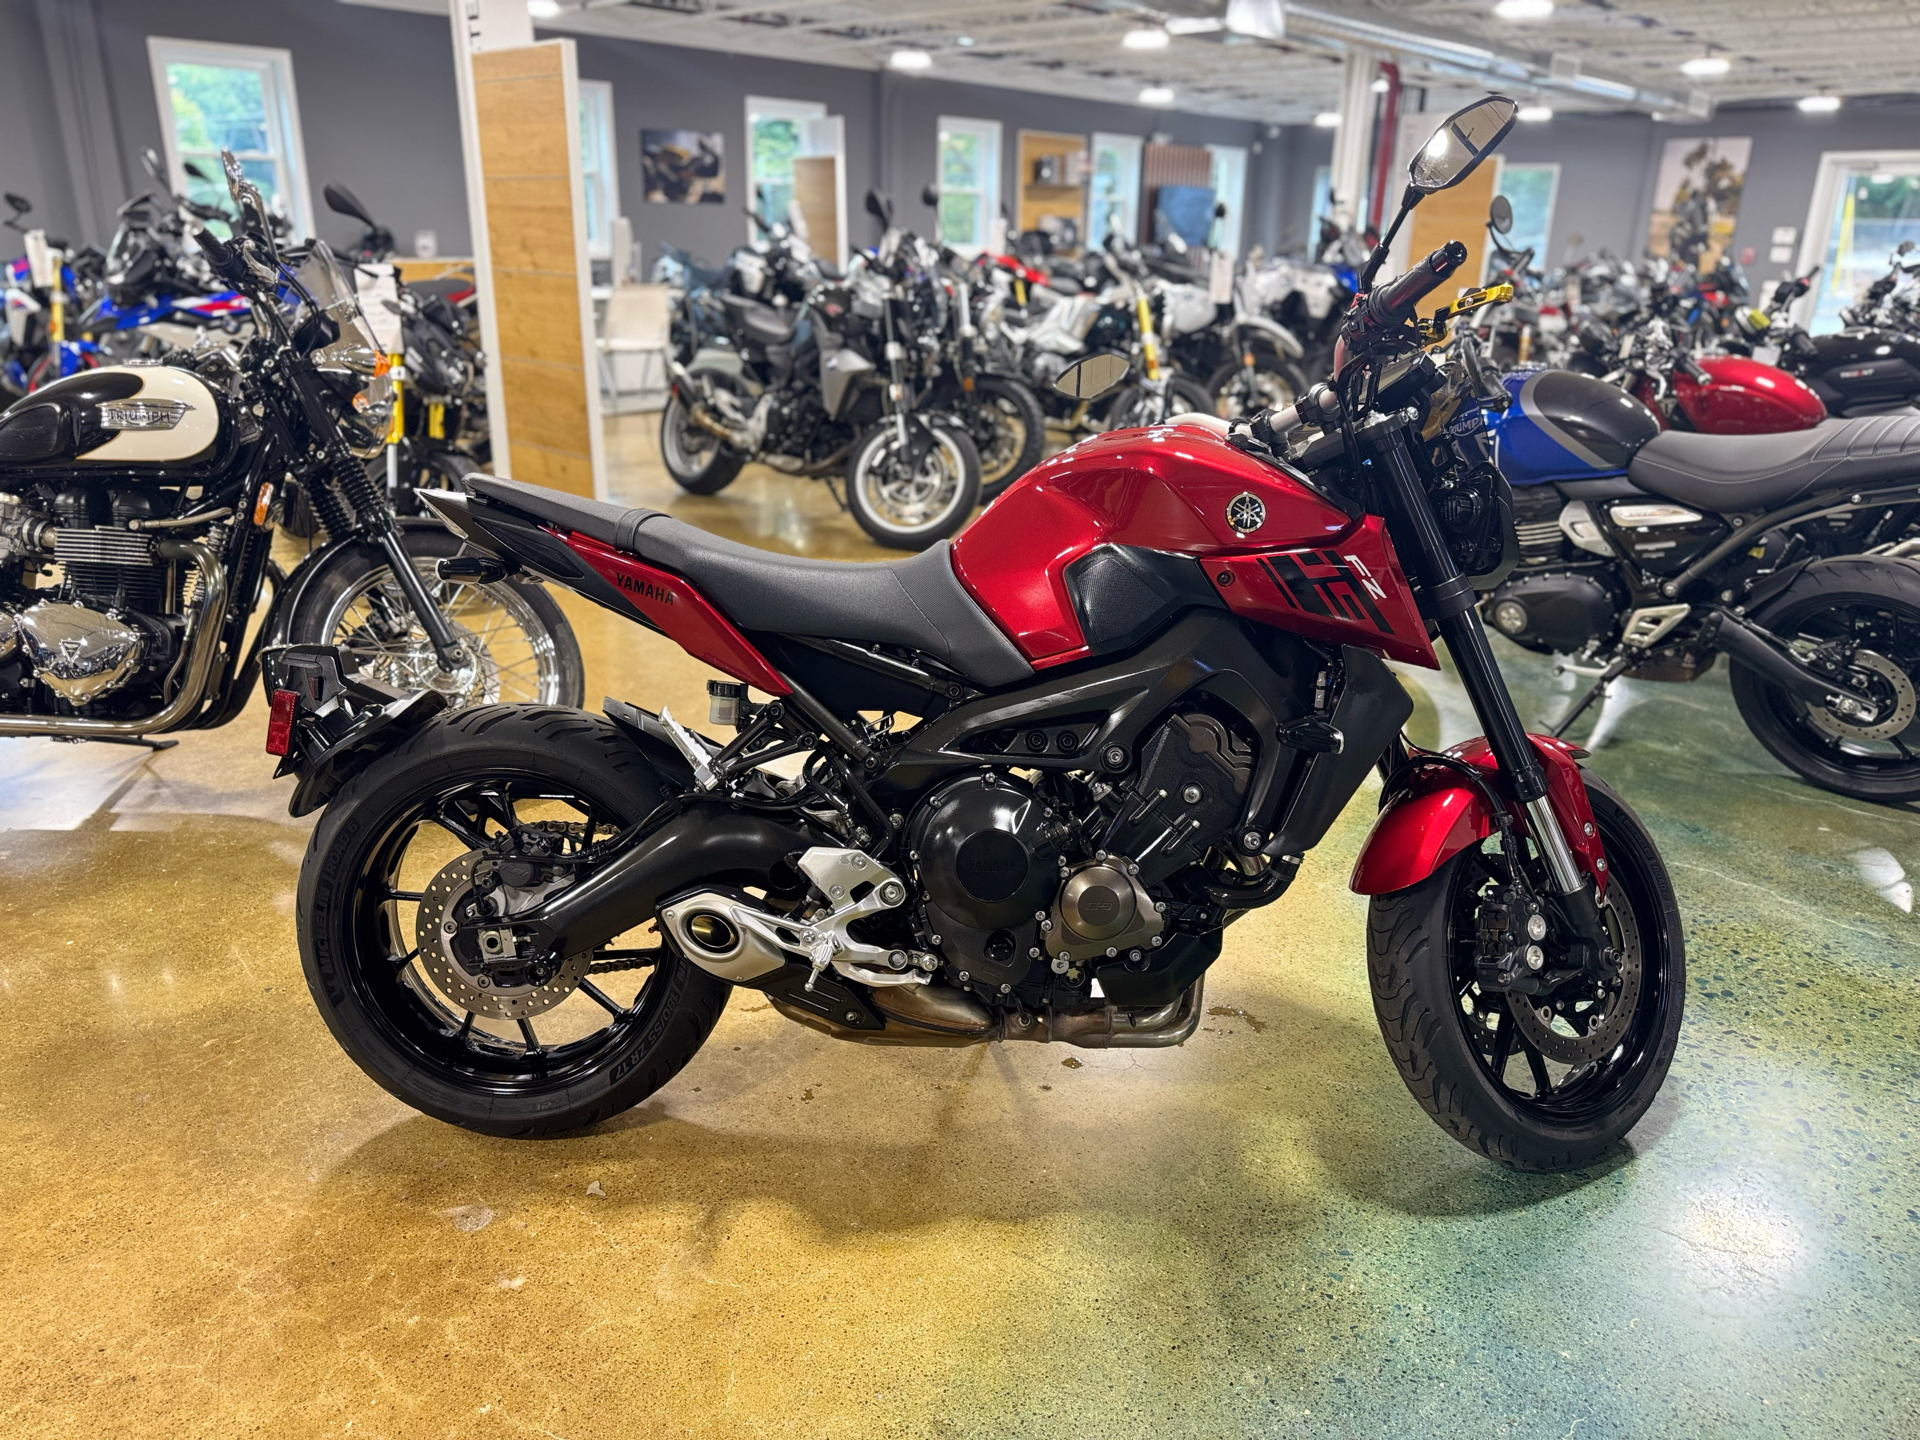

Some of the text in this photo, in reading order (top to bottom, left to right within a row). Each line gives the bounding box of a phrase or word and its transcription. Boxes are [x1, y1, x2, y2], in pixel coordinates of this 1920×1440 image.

[107, 408, 170, 422] TRIUMPH
[1449, 416, 1483, 434] RIUMP
[615, 571, 675, 606] YAMAHA
[1343, 555, 1387, 600] FZ
[968, 858, 1016, 873] YAMAHA
[1652, 865, 1667, 891] ROAD
[313, 821, 359, 970] MICHELIN ROAD 6
[615, 992, 678, 1079] 180/55 ZR 17
